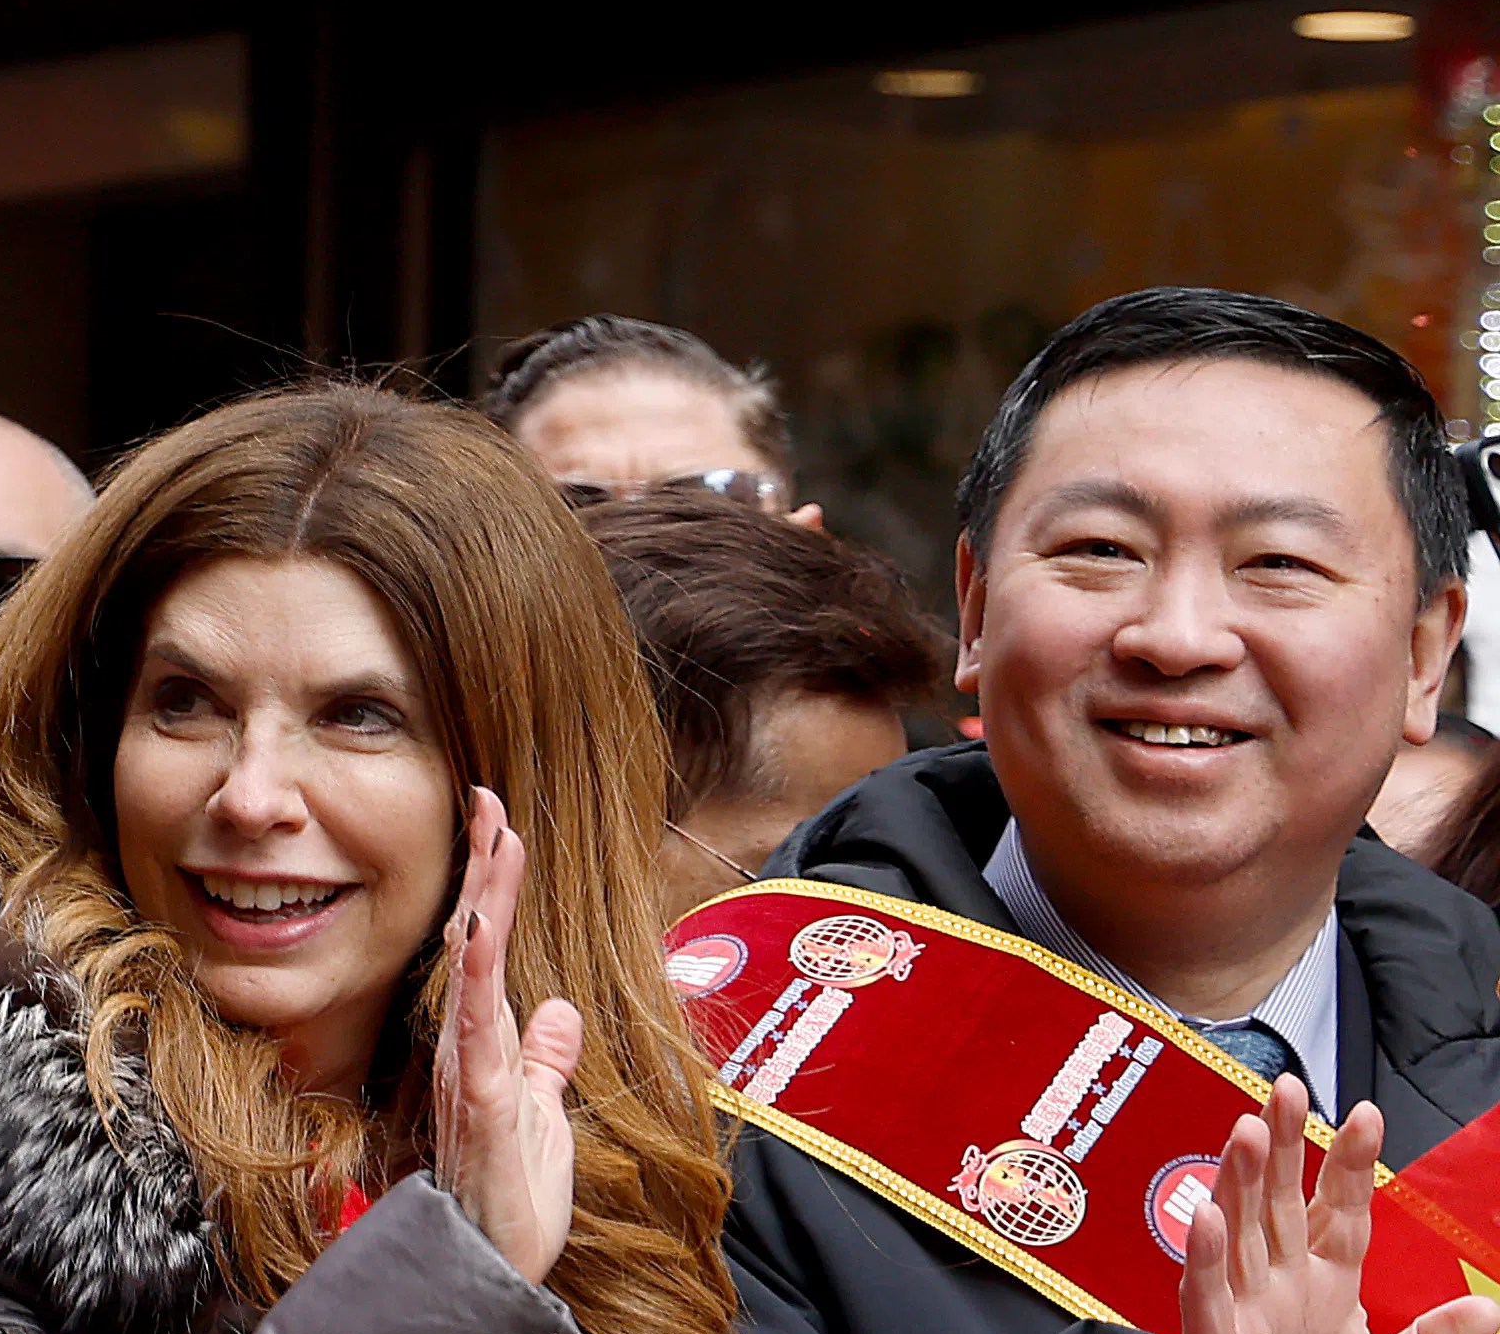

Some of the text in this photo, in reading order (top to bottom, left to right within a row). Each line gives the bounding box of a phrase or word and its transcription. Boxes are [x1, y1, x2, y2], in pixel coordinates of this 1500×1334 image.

[1062, 1035, 1166, 1164] Better Chinatown USA
